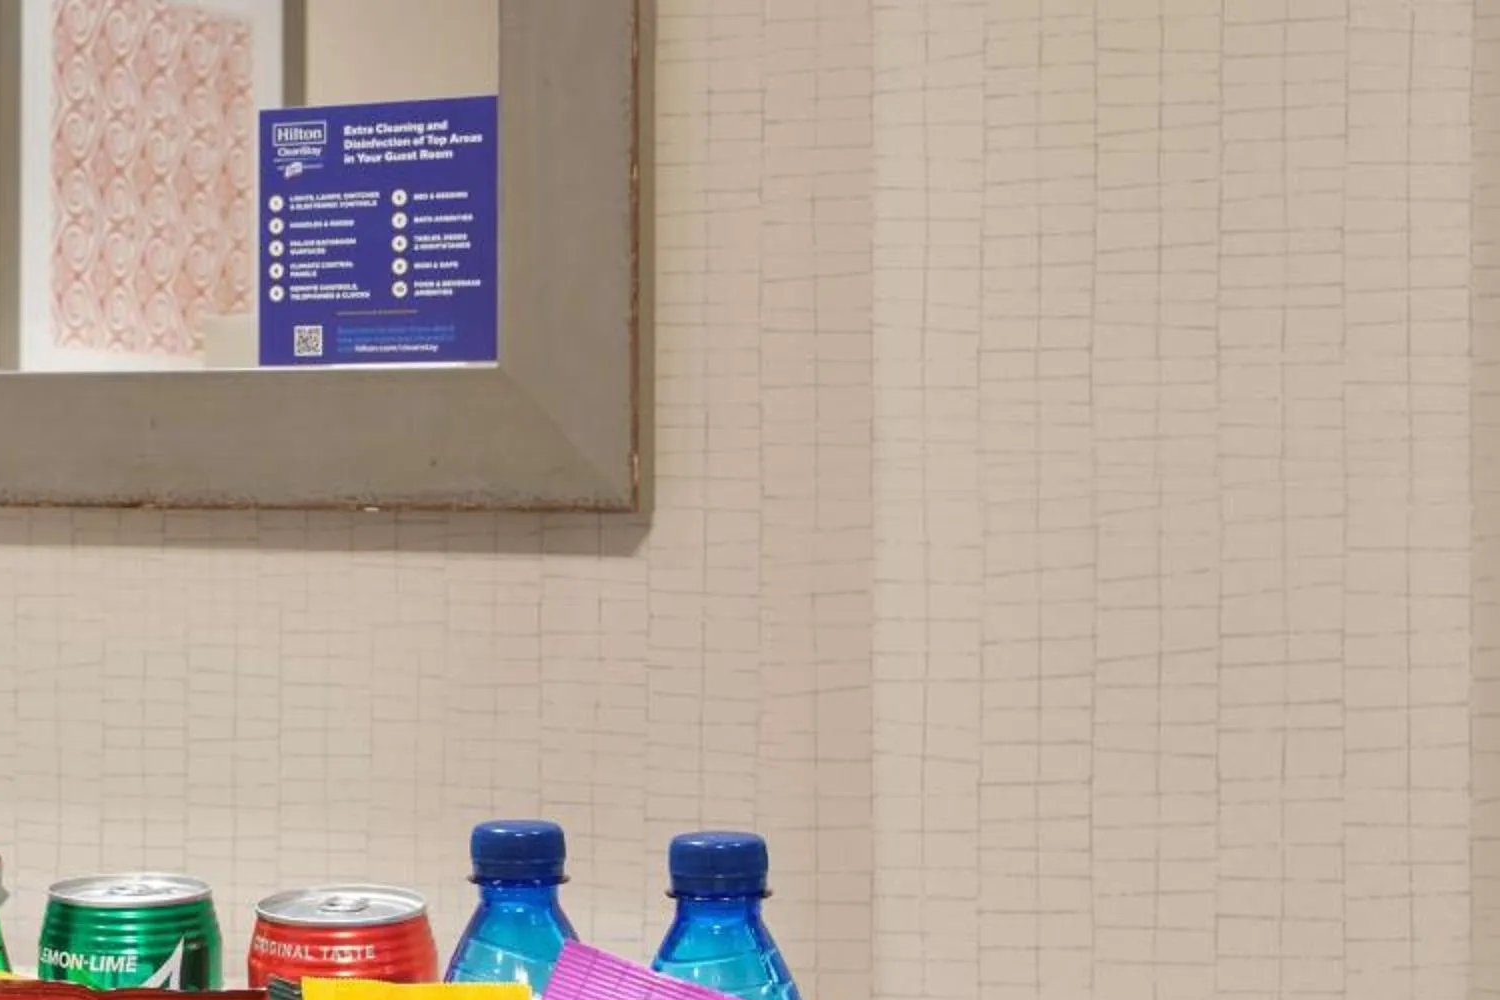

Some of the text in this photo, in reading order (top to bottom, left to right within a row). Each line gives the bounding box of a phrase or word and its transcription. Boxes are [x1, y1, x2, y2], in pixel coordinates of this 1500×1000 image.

[276, 126, 323, 142] Hilton
[343, 120, 448, 137] Extra Cleaning and
[343, 133, 483, 151] Disinfection of Top Areas
[343, 149, 453, 164] in Your Guest Room
